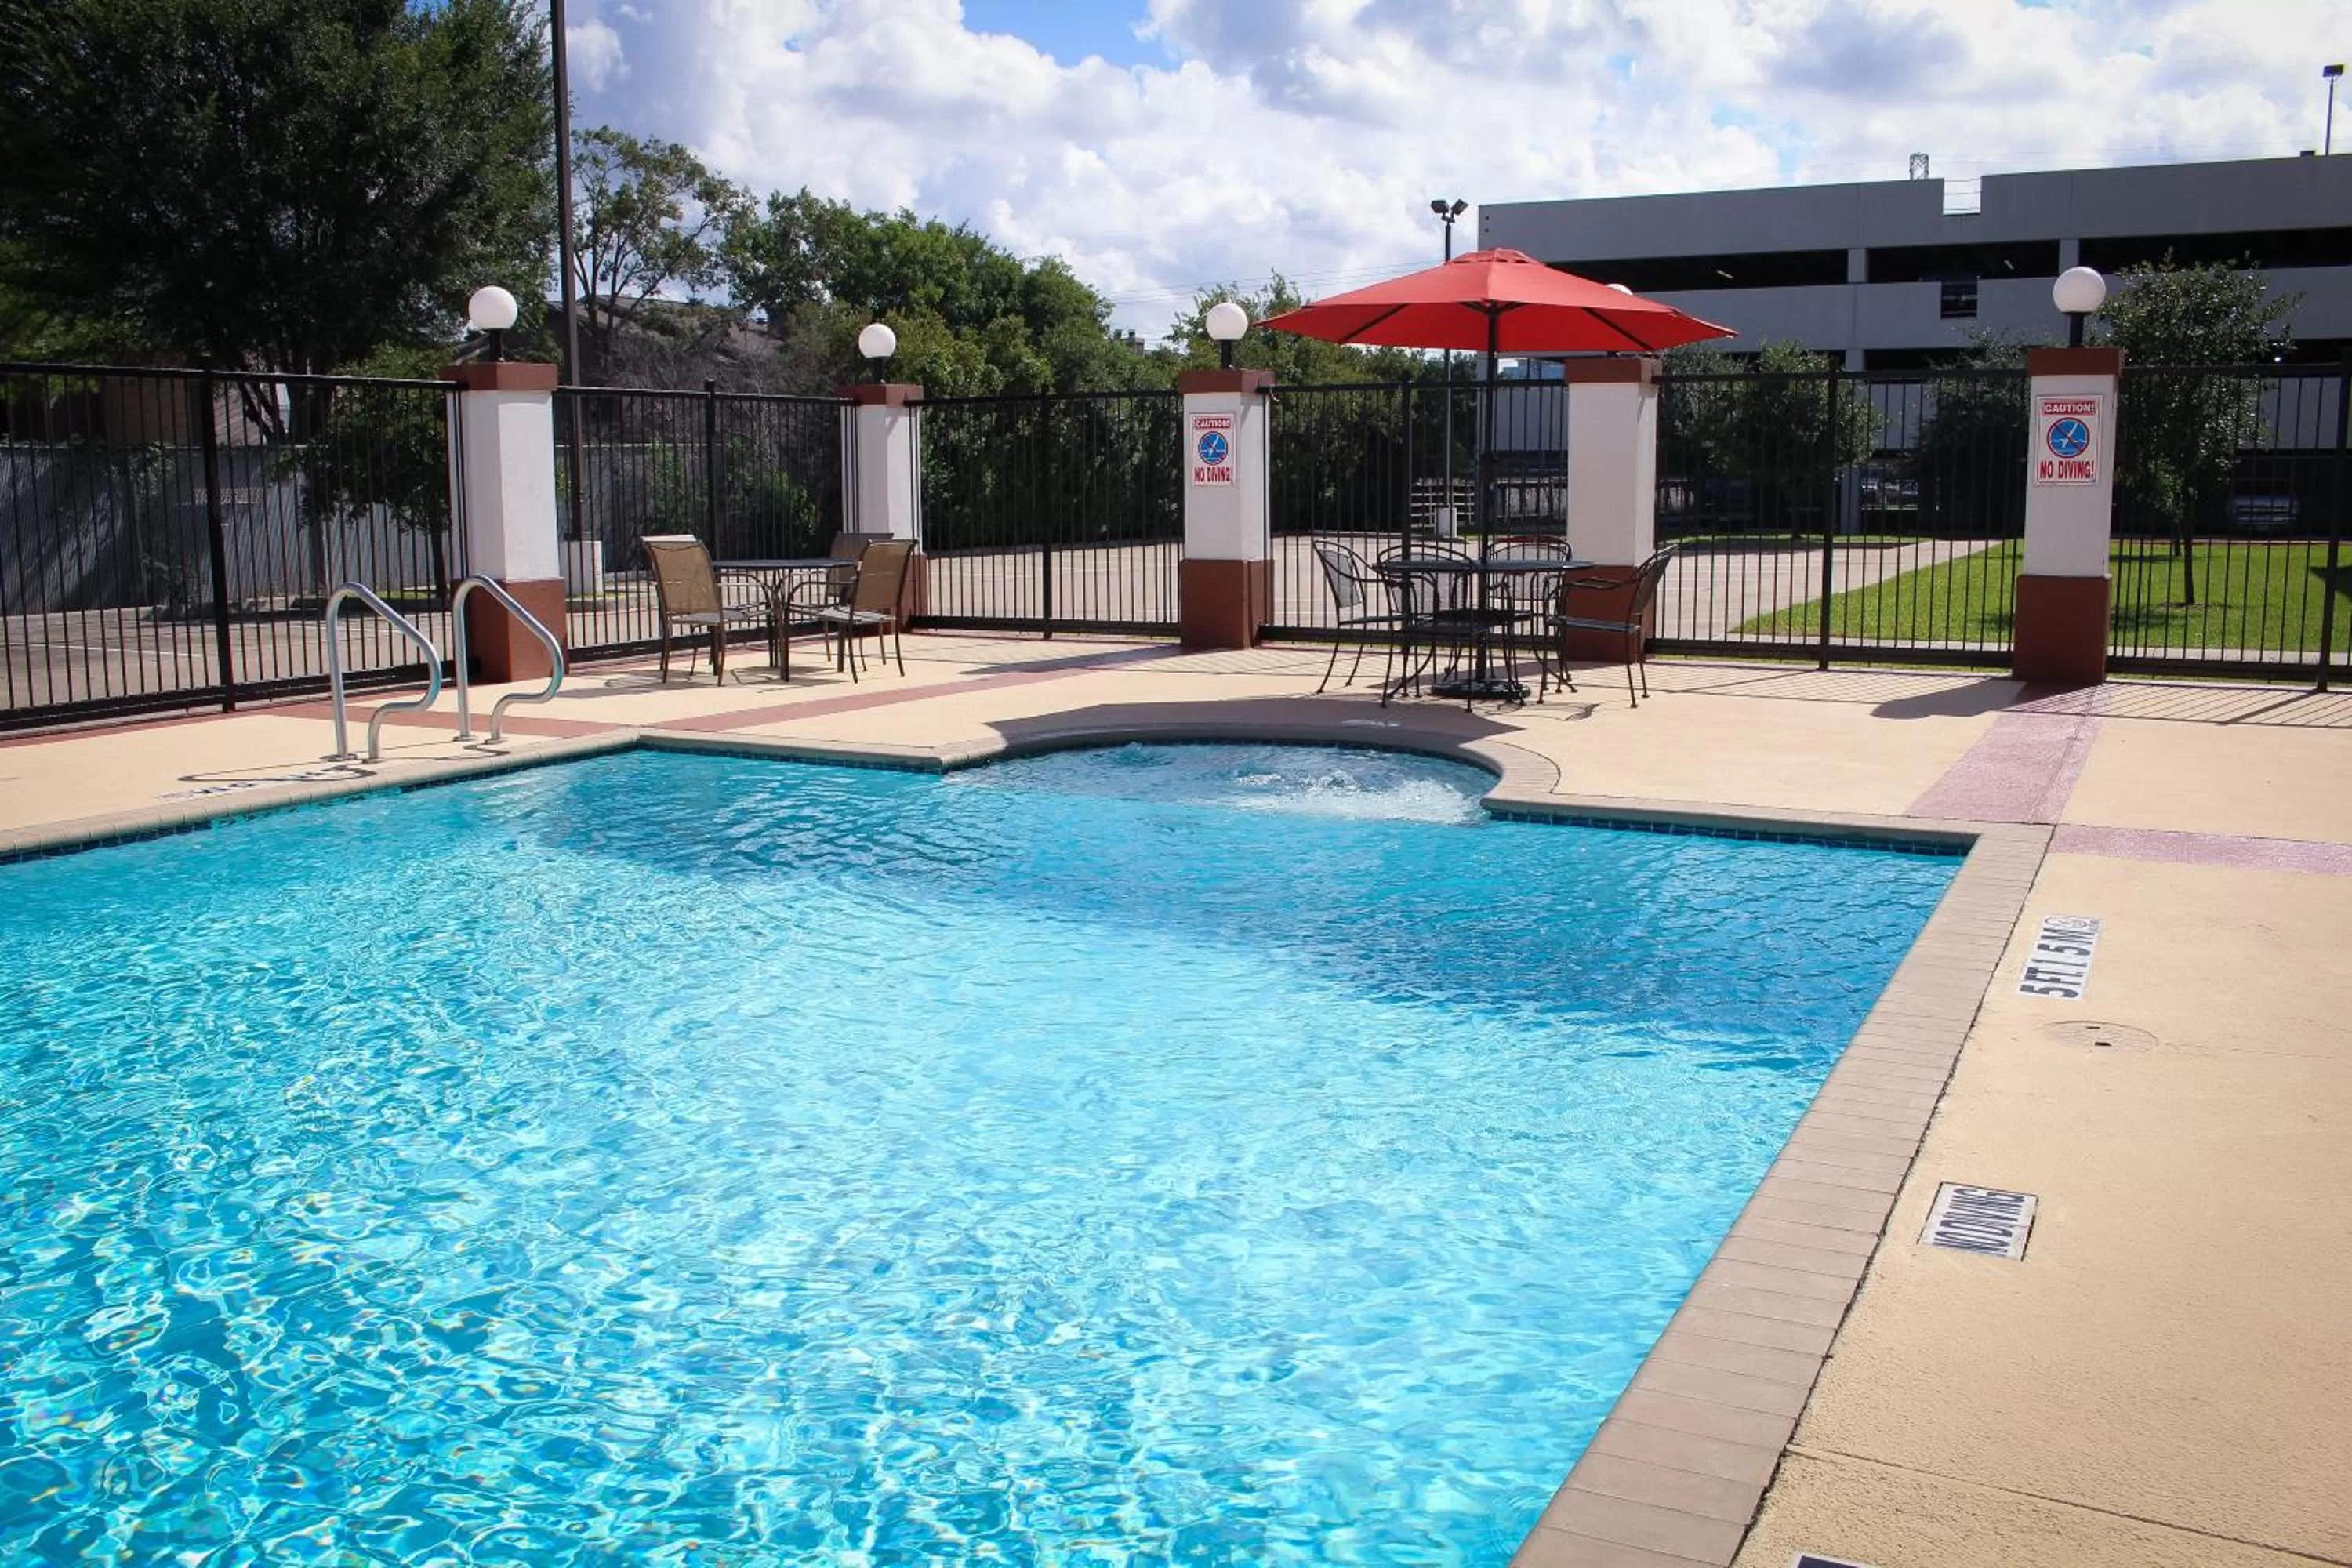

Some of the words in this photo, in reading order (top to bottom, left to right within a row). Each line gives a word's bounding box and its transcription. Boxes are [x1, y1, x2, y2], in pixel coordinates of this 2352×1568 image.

[2044, 402, 2096, 414] CAUTION!
[1194, 466, 1205, 482] NO
[2040, 461, 2054, 479] NO
[2058, 461, 2094, 479] DIVING!
[1940, 1188, 2025, 1237] DIVING
[1932, 1232, 2010, 1256] NO
